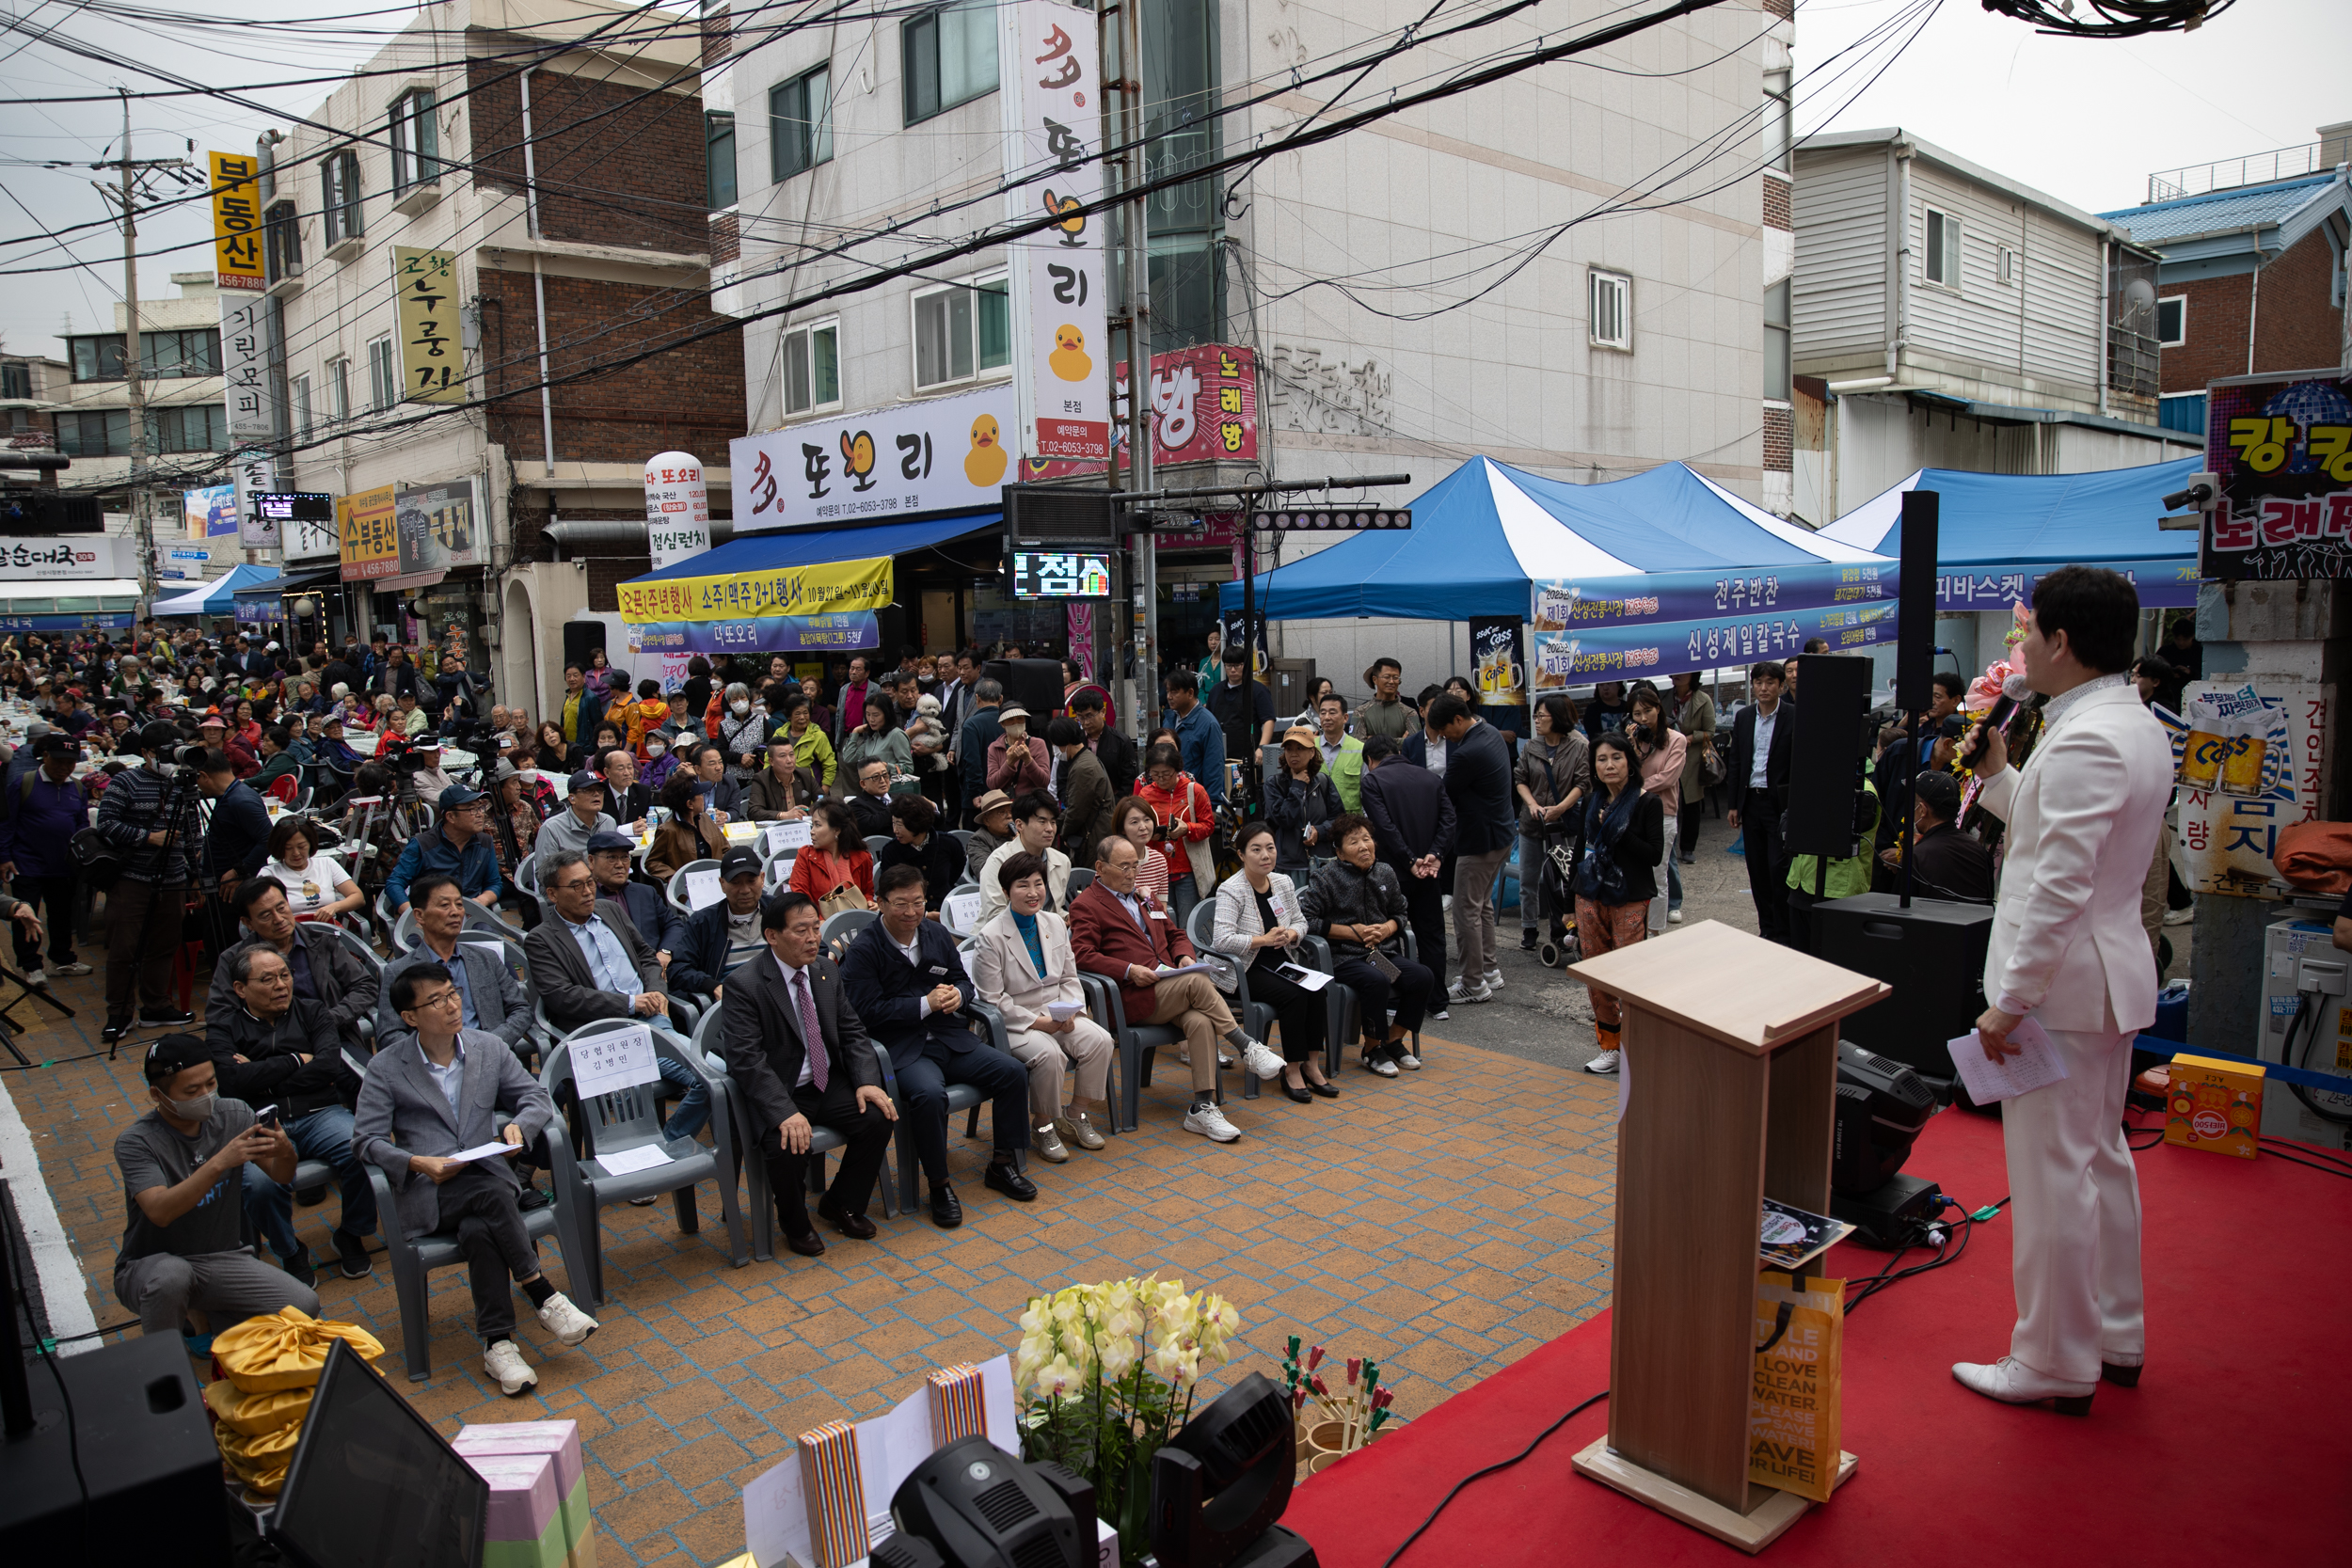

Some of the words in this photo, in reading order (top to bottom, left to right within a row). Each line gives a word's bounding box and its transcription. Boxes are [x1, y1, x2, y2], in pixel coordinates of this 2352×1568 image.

[1035, 23, 1081, 89] 多
[217, 158, 259, 270] 부동산
[405, 256, 451, 277] 고향
[219, 275, 265, 290] 456-7880
[409, 278, 451, 391] 누룽지
[231, 306, 262, 420] 기린모피
[1063, 399, 1082, 414] 본점
[1219, 351, 1244, 452] 노래방
[233, 422, 270, 432] 455-7806
[1057, 425, 1088, 438] 예약문의
[1041, 439, 1104, 454] T.02-6053-3798
[661, 468, 700, 484] 또오리
[662, 491, 676, 500] 국산
[816, 503, 841, 517] 예약문의
[842, 498, 898, 515] T.02-6053-3798
[904, 495, 919, 508] 본점
[429, 501, 469, 548] 누룽지
[652, 530, 706, 551] 점심런치
[366, 559, 399, 575] 456-7880
[1842, 568, 1861, 583] 닭강정
[1862, 566, 1879, 581] 5천원
[623, 584, 692, 616] 오픈1주년행사
[703, 578, 752, 611] 소주/맥주
[754, 576, 803, 608] 2+1행사
[1546, 589, 1571, 600] 2023년
[1713, 575, 1780, 610] 전주반찬
[1834, 586, 1866, 602] 돼지껍데기
[1866, 584, 1883, 598] 5천원
[442, 610, 469, 623] 고향
[833, 615, 850, 627] 1만원
[1546, 604, 1569, 622] 제1회
[1571, 599, 1624, 620] 신성전통시장
[713, 622, 757, 646] 다또오리
[1687, 618, 1801, 662] 신성제일칼국수
[446, 624, 469, 667] 누룽
[1546, 641, 1571, 654] 2023년
[1545, 657, 1571, 674] 제1회
[1572, 653, 1624, 673] 신성전통시장
[2236, 684, 2258, 701] 더
[2217, 698, 2261, 719] 짜릿하게
[580, 1036, 643, 1060] 당협위원장
[592, 1053, 628, 1071] 김병민
[1775, 1345, 1818, 1363] AND
[1764, 1355, 1818, 1379] LOVE
[1753, 1368, 1817, 1396] CLEAN
[1752, 1384, 1820, 1411] WATER.
[1751, 1401, 1816, 1425] PLEASE
[1750, 1426, 1817, 1450] WATER!
[1772, 1418, 1816, 1438] SAVE
[1771, 1462, 1817, 1486] LIFE!
